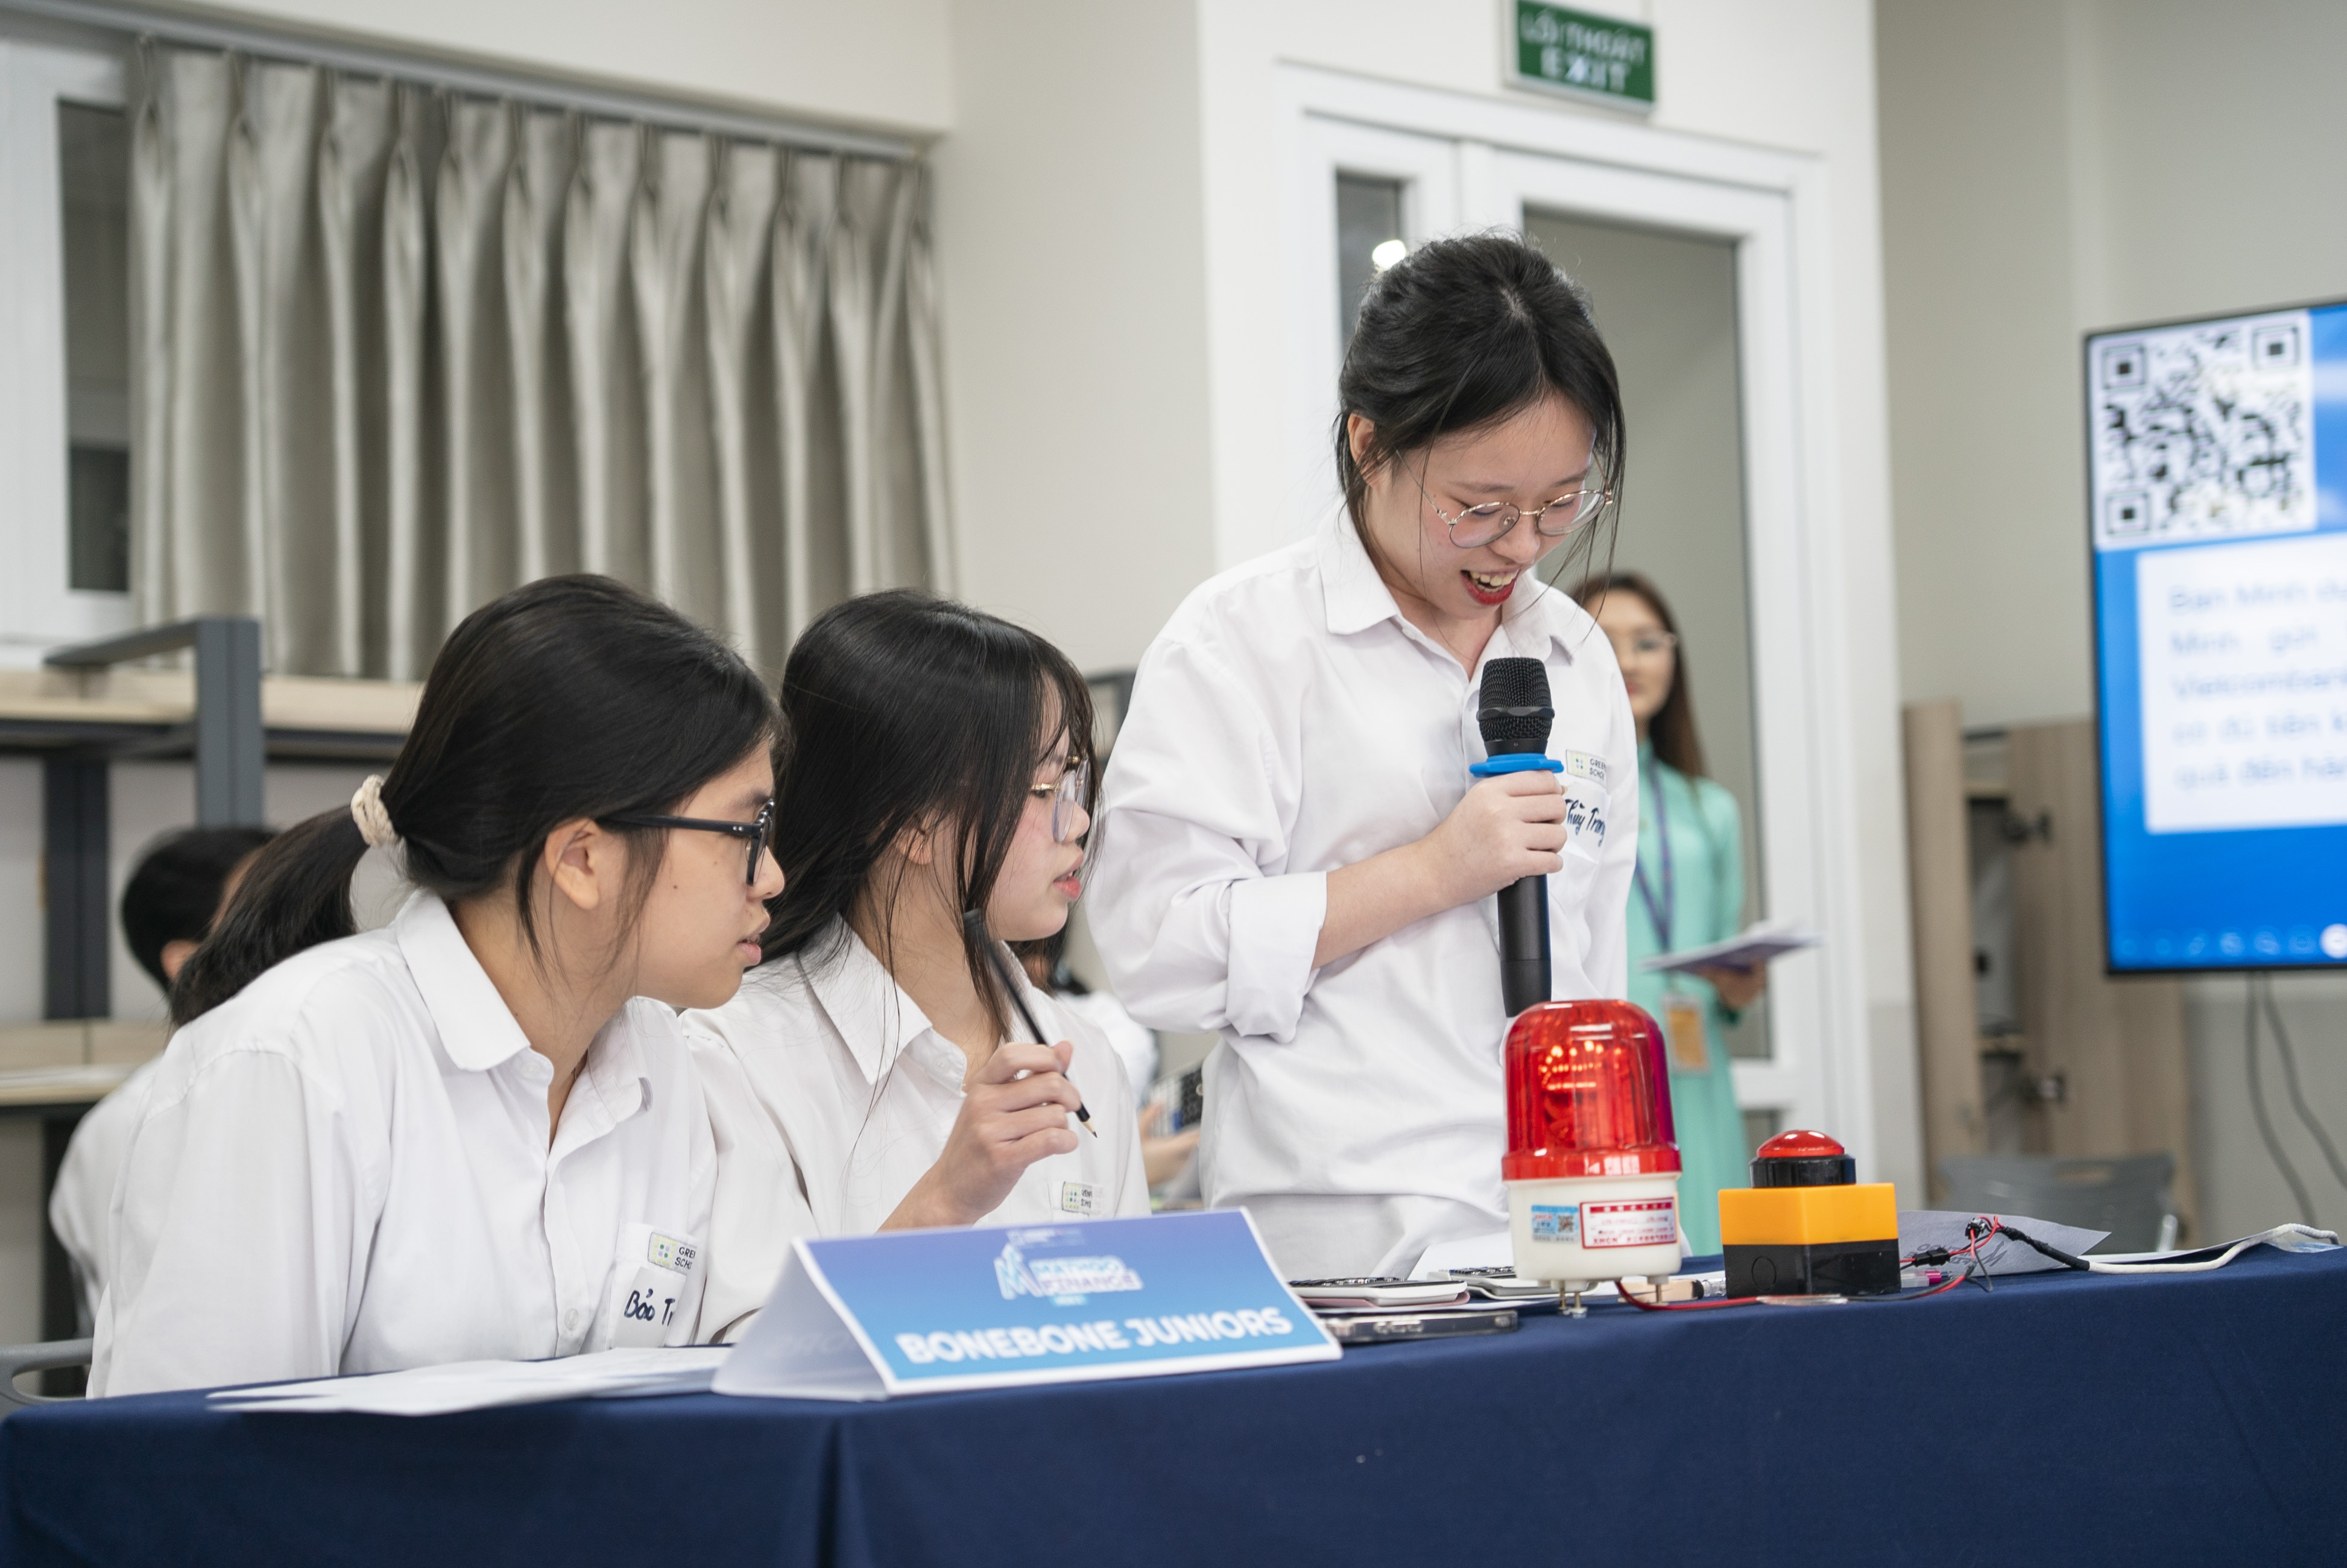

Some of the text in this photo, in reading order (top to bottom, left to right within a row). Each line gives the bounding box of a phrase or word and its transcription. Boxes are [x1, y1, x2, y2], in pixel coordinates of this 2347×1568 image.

[1541, 46, 1630, 92] EXIT
[624, 1288, 655, 1321] Bảo
[896, 1321, 1131, 1364] BONEBONE
[1125, 1307, 1293, 1347] JUNIORS
